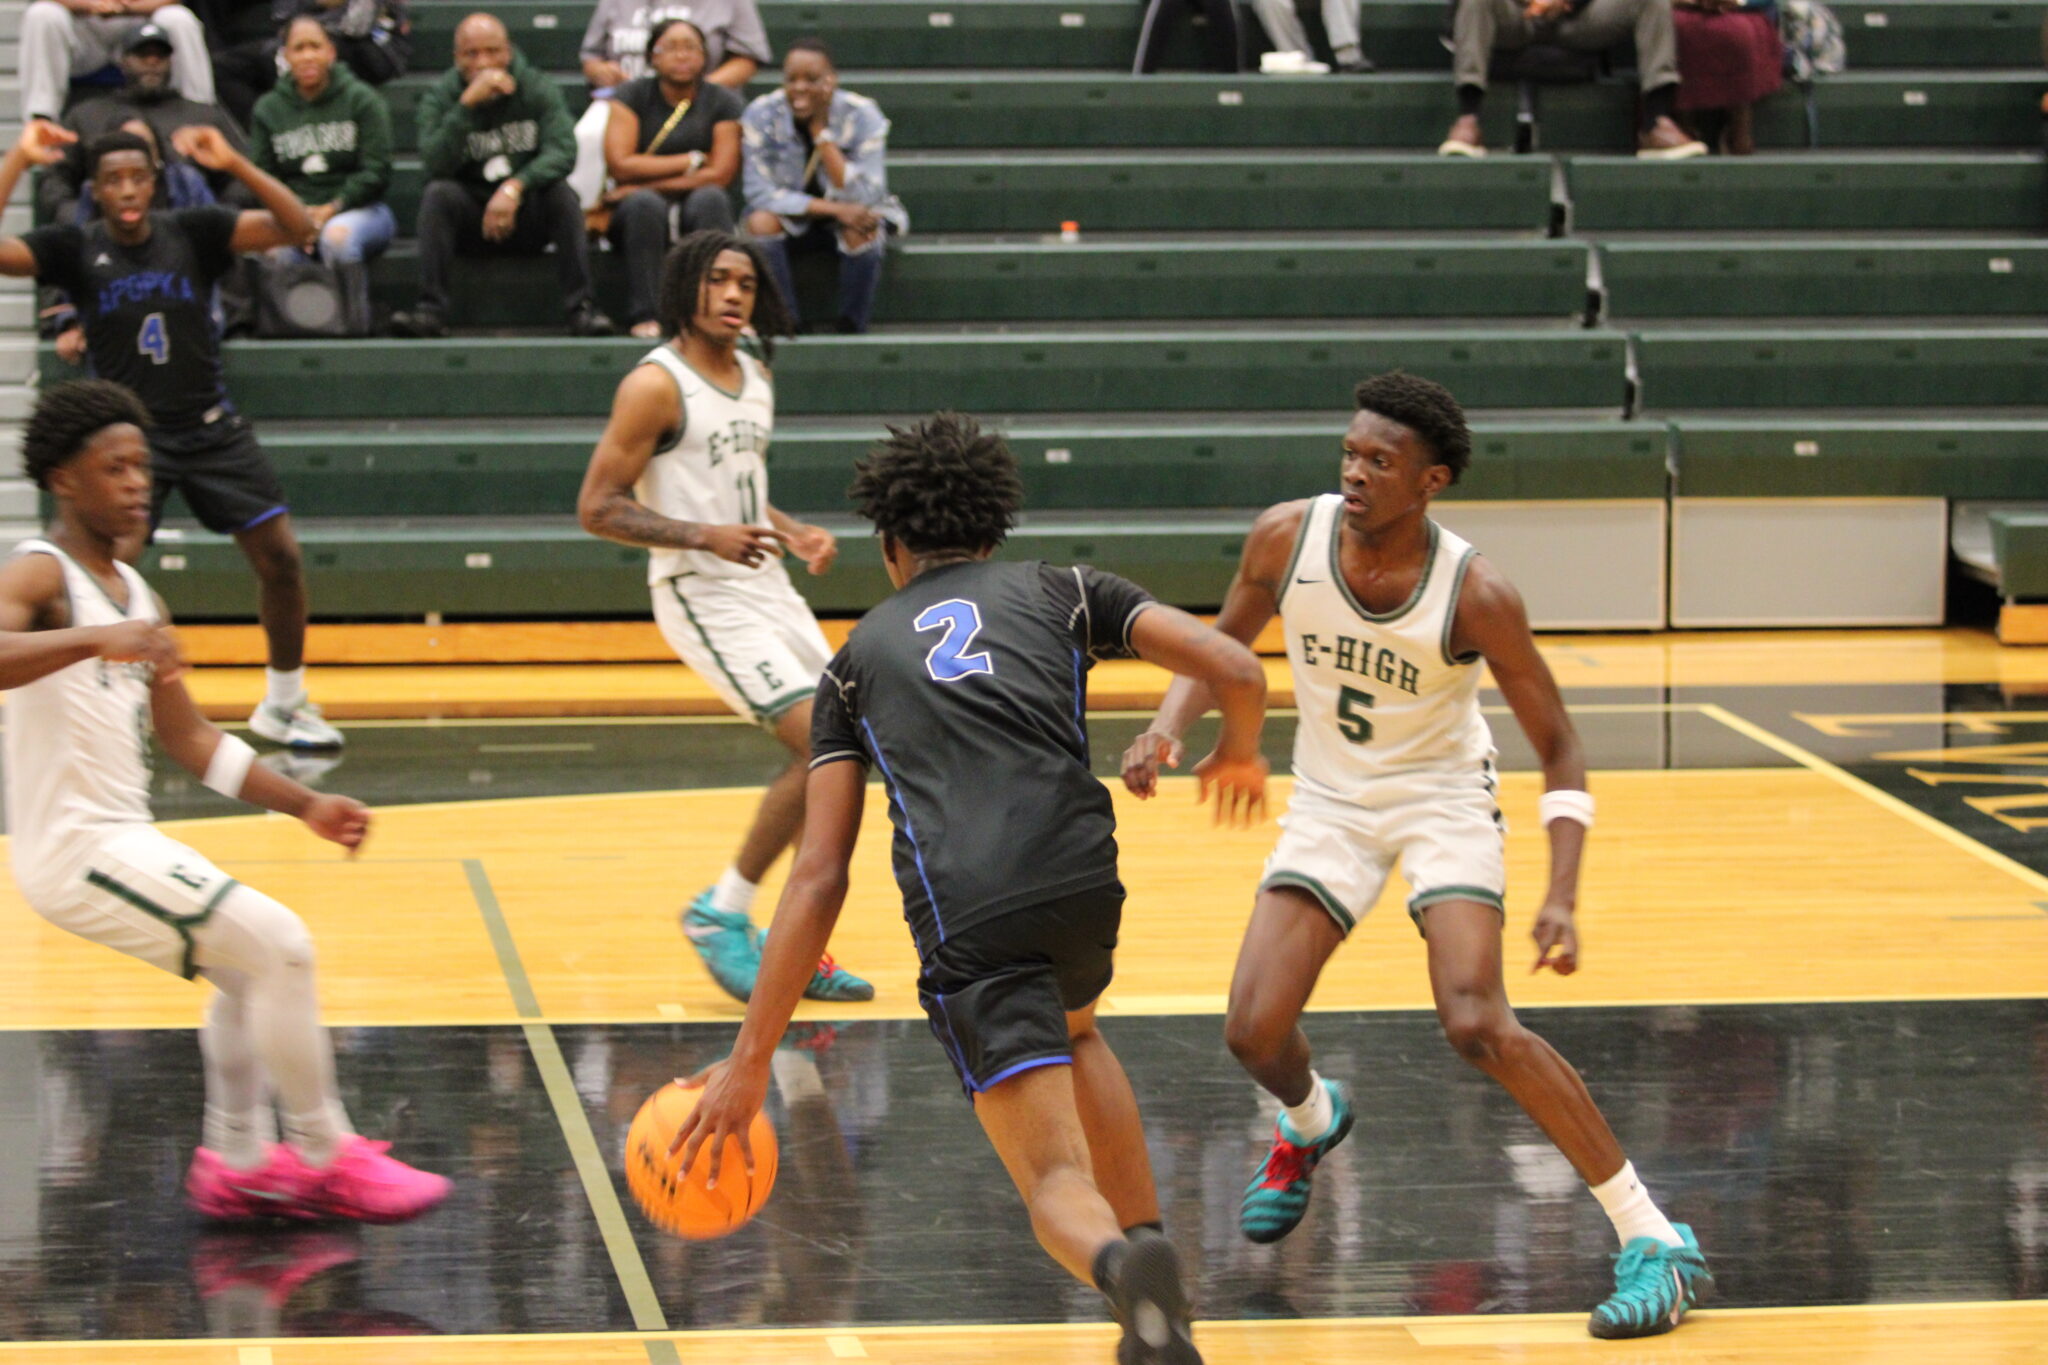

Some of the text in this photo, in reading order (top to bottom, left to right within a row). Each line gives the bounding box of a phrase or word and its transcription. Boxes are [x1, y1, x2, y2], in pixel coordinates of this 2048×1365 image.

[137, 311, 170, 365] 4
[736, 470, 758, 524] 11
[913, 598, 994, 681] 2
[1301, 633, 1421, 696] E-HIGH
[754, 660, 784, 690] E
[1337, 684, 1376, 745] 5
